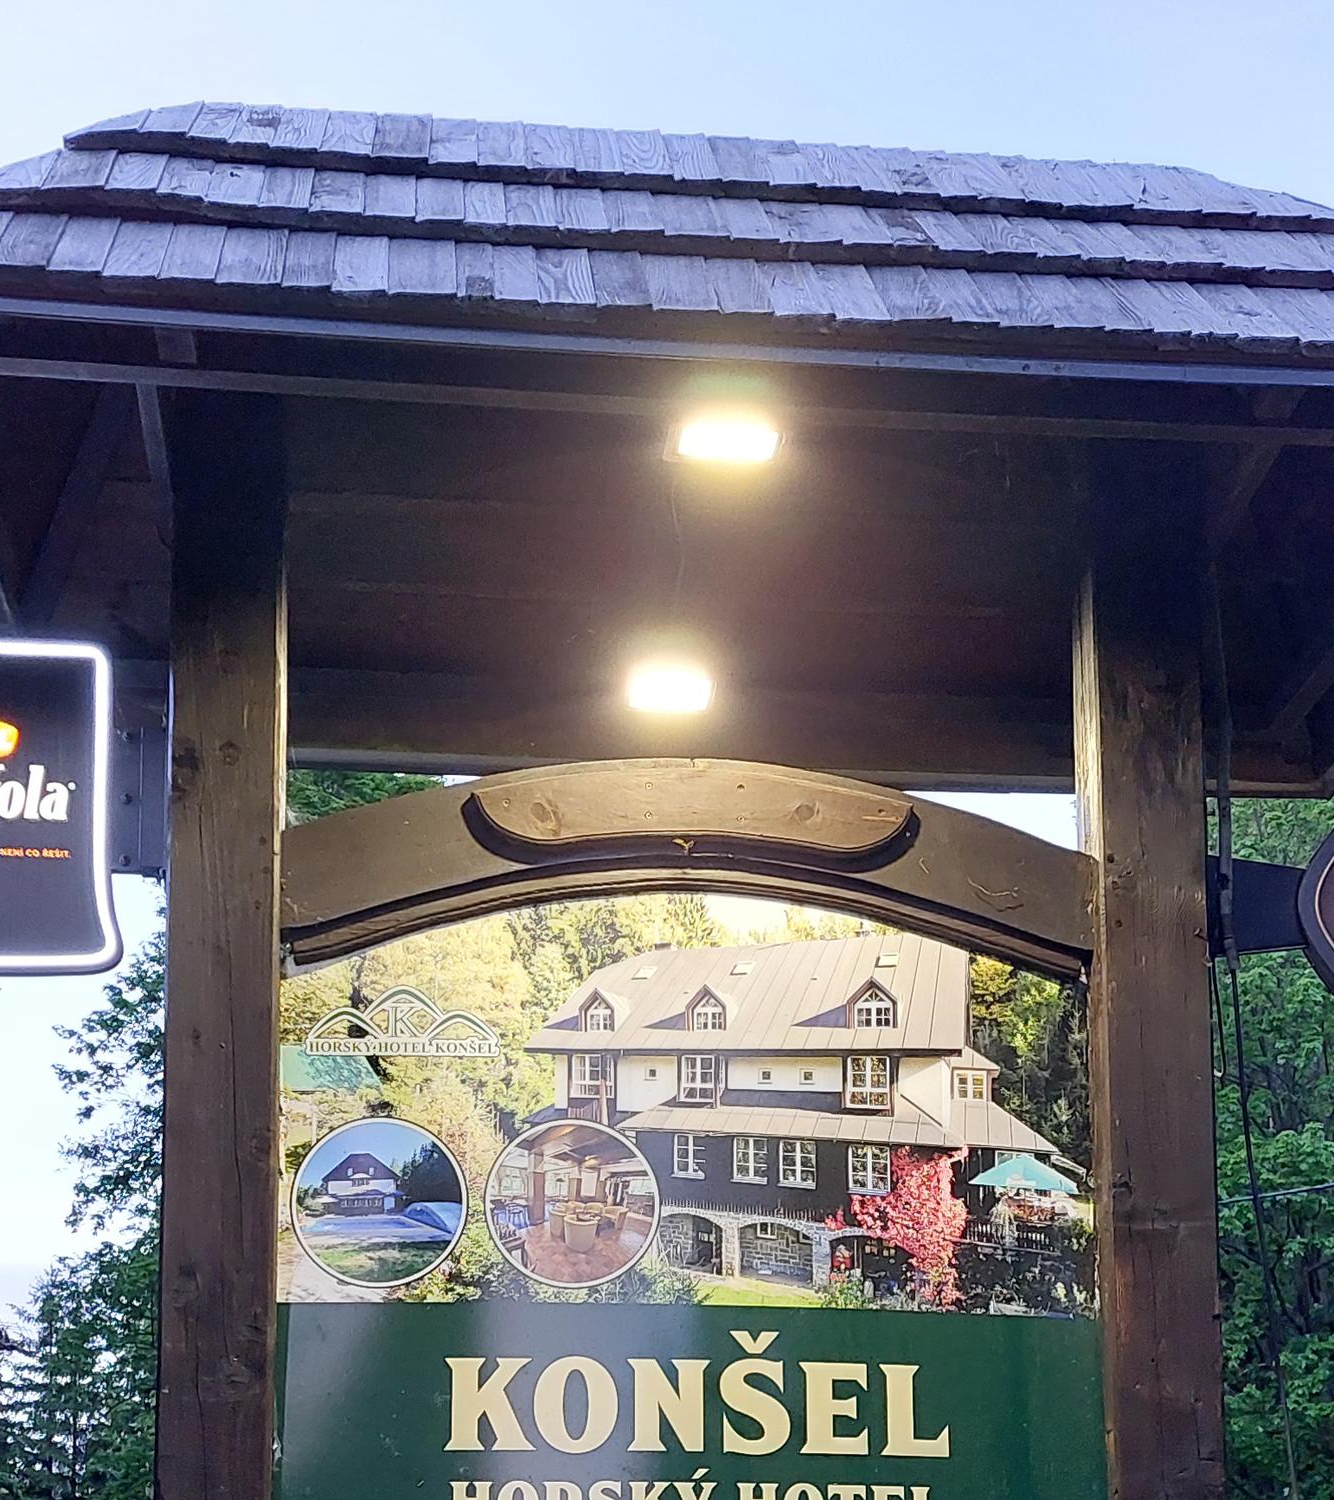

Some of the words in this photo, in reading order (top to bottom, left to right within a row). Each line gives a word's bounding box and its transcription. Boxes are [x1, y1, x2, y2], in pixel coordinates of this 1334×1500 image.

[309, 1037, 373, 1053] HORSKÝ
[378, 1041, 430, 1054] HOTEL
[435, 1040, 497, 1054] KONŠEL
[443, 1330, 950, 1457] KONŠEL
